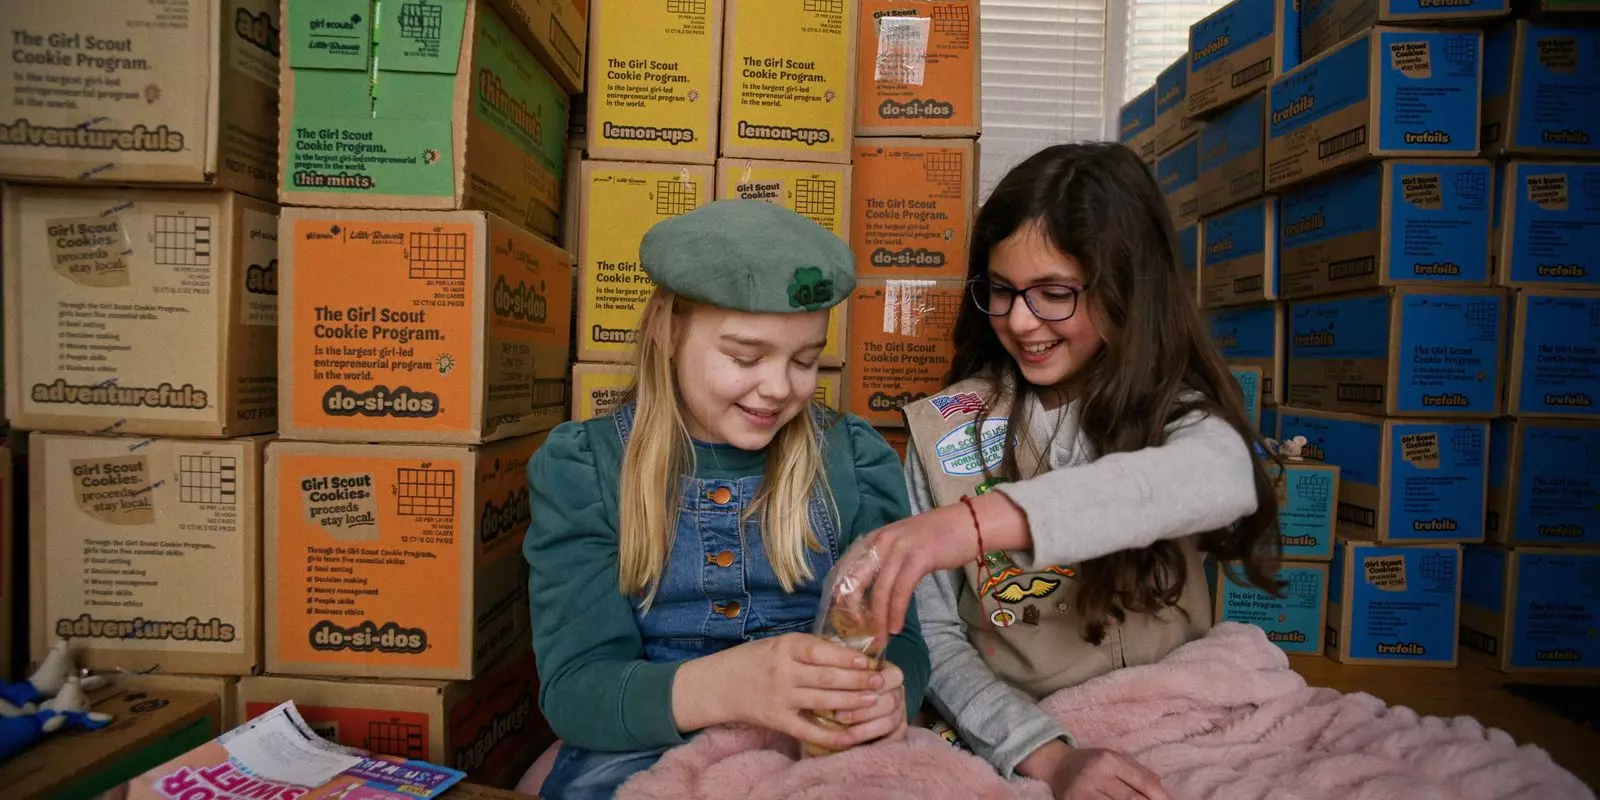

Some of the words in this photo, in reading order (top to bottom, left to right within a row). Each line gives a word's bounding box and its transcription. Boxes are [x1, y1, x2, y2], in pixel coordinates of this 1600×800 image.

[310, 19, 325, 29] girl
[12, 30, 43, 46] The
[48, 33, 79, 49] Girl
[85, 35, 132, 51] Scout
[12, 50, 71, 65] Cookie
[743, 56, 762, 67] The
[764, 58, 783, 68] Girl
[786, 60, 815, 70] Scout
[608, 58, 626, 69] The
[628, 60, 647, 69] Girl
[650, 61, 679, 70] Scout
[607, 71, 641, 80] Cookie
[742, 69, 777, 79] Cookie
[626, 84, 649, 93] largest
[650, 86, 673, 94] girl-led
[761, 83, 784, 92] largest
[786, 85, 810, 93] girl-led
[606, 93, 657, 101] entrepreneurial
[658, 95, 685, 103] program
[741, 91, 793, 100] entrepreneurial
[793, 94, 822, 102] program
[881, 101, 951, 117] do-si-dos
[1273, 95, 1314, 124] trefoils
[297, 128, 316, 139] The
[319, 129, 339, 140] Girl
[342, 130, 373, 140] Scout
[604, 121, 693, 144] lemon-ups
[739, 121, 829, 144] lemon-ups
[1405, 131, 1449, 143] trefoils
[297, 140, 333, 151] Cookie
[315, 154, 338, 163] largest
[295, 162, 323, 171] program
[737, 184, 753, 192] Girl
[756, 182, 780, 191] Scout
[867, 199, 884, 208] The
[887, 199, 905, 208] Girl
[908, 200, 936, 209] Scout
[866, 210, 900, 219] Cookie
[48, 223, 74, 236] Girl
[78, 221, 118, 234] Scout
[56, 250, 108, 263] proceeds
[873, 250, 943, 266] do-si-dos
[69, 263, 91, 274] stay
[596, 261, 616, 271] The
[618, 262, 637, 271] Girl
[1415, 263, 1460, 275] trefoils
[596, 273, 631, 283] Cookie
[616, 288, 639, 297] largest
[495, 278, 546, 321] do-si-dos
[314, 306, 343, 321] The
[347, 307, 376, 322] Girl
[380, 308, 425, 323] Scout
[314, 324, 368, 339] Cookie
[315, 345, 323, 355] is
[326, 345, 341, 355] the
[343, 346, 376, 358] largest
[379, 347, 413, 358] girl-led
[864, 342, 882, 351] The
[885, 342, 903, 352] Girl
[907, 343, 936, 352] Scout
[864, 353, 898, 362] Cookie
[314, 359, 388, 369] entrepreneurial
[391, 361, 432, 372] program
[314, 370, 323, 379] in
[325, 370, 341, 380] the
[344, 371, 373, 380] world.
[32, 380, 207, 408] adventurefuls
[1423, 394, 1469, 406] trefoils
[326, 389, 436, 414] do-si-dos
[958, 429, 991, 448] SCOTS
[951, 449, 988, 468] HORNES
[73, 464, 99, 476] Girl
[103, 462, 143, 474] Scout
[302, 477, 328, 490] Girl
[331, 475, 371, 488] Scout
[82, 488, 138, 503] proceeds
[94, 501, 117, 512] stay
[310, 503, 359, 518] proceeds
[321, 515, 343, 527] stay
[346, 512, 375, 524] local.
[1414, 519, 1457, 531] trefoils
[1229, 592, 1241, 600] The
[1243, 592, 1256, 600] Girl
[56, 613, 235, 642] adventurefuls
[313, 624, 424, 650] do-si-dos
[1378, 643, 1425, 655] trefoils
